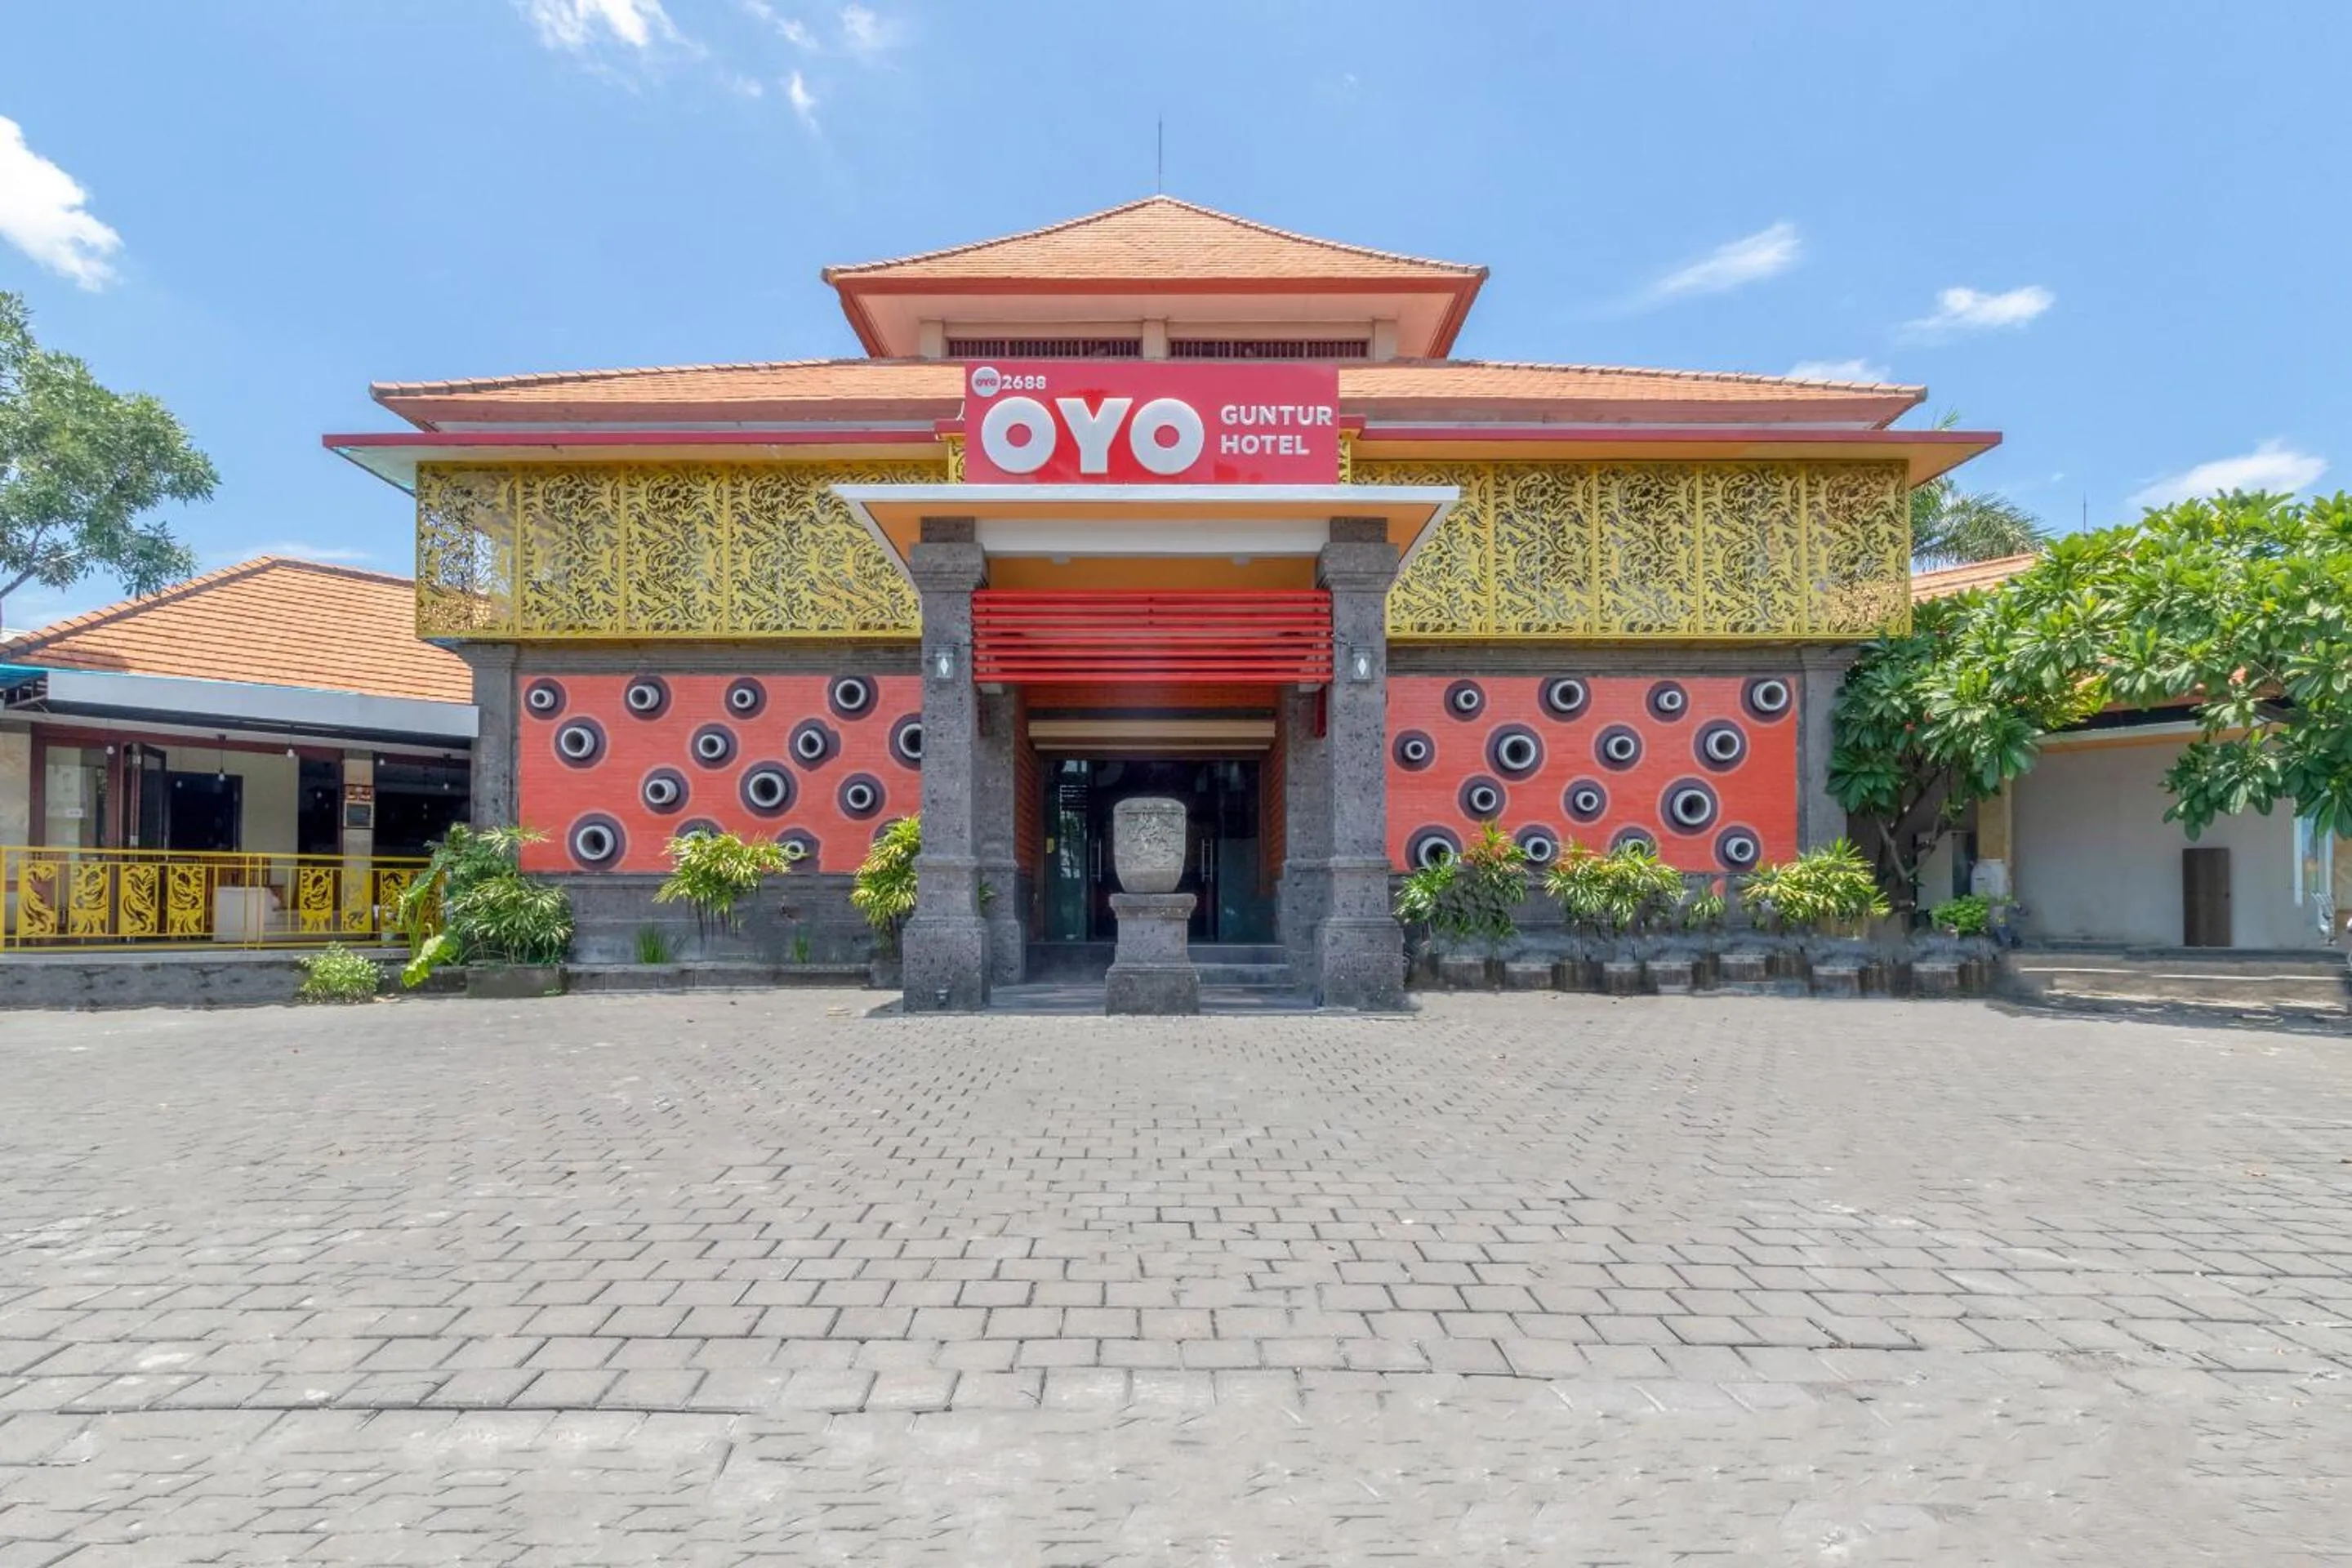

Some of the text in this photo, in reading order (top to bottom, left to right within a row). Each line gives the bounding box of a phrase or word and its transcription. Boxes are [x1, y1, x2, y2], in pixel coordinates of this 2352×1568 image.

[1001, 375, 1046, 390] 2688
[1221, 405, 1332, 425] GUNTUR
[982, 397, 1205, 474] OYO
[1221, 434, 1309, 455] HOTEL
